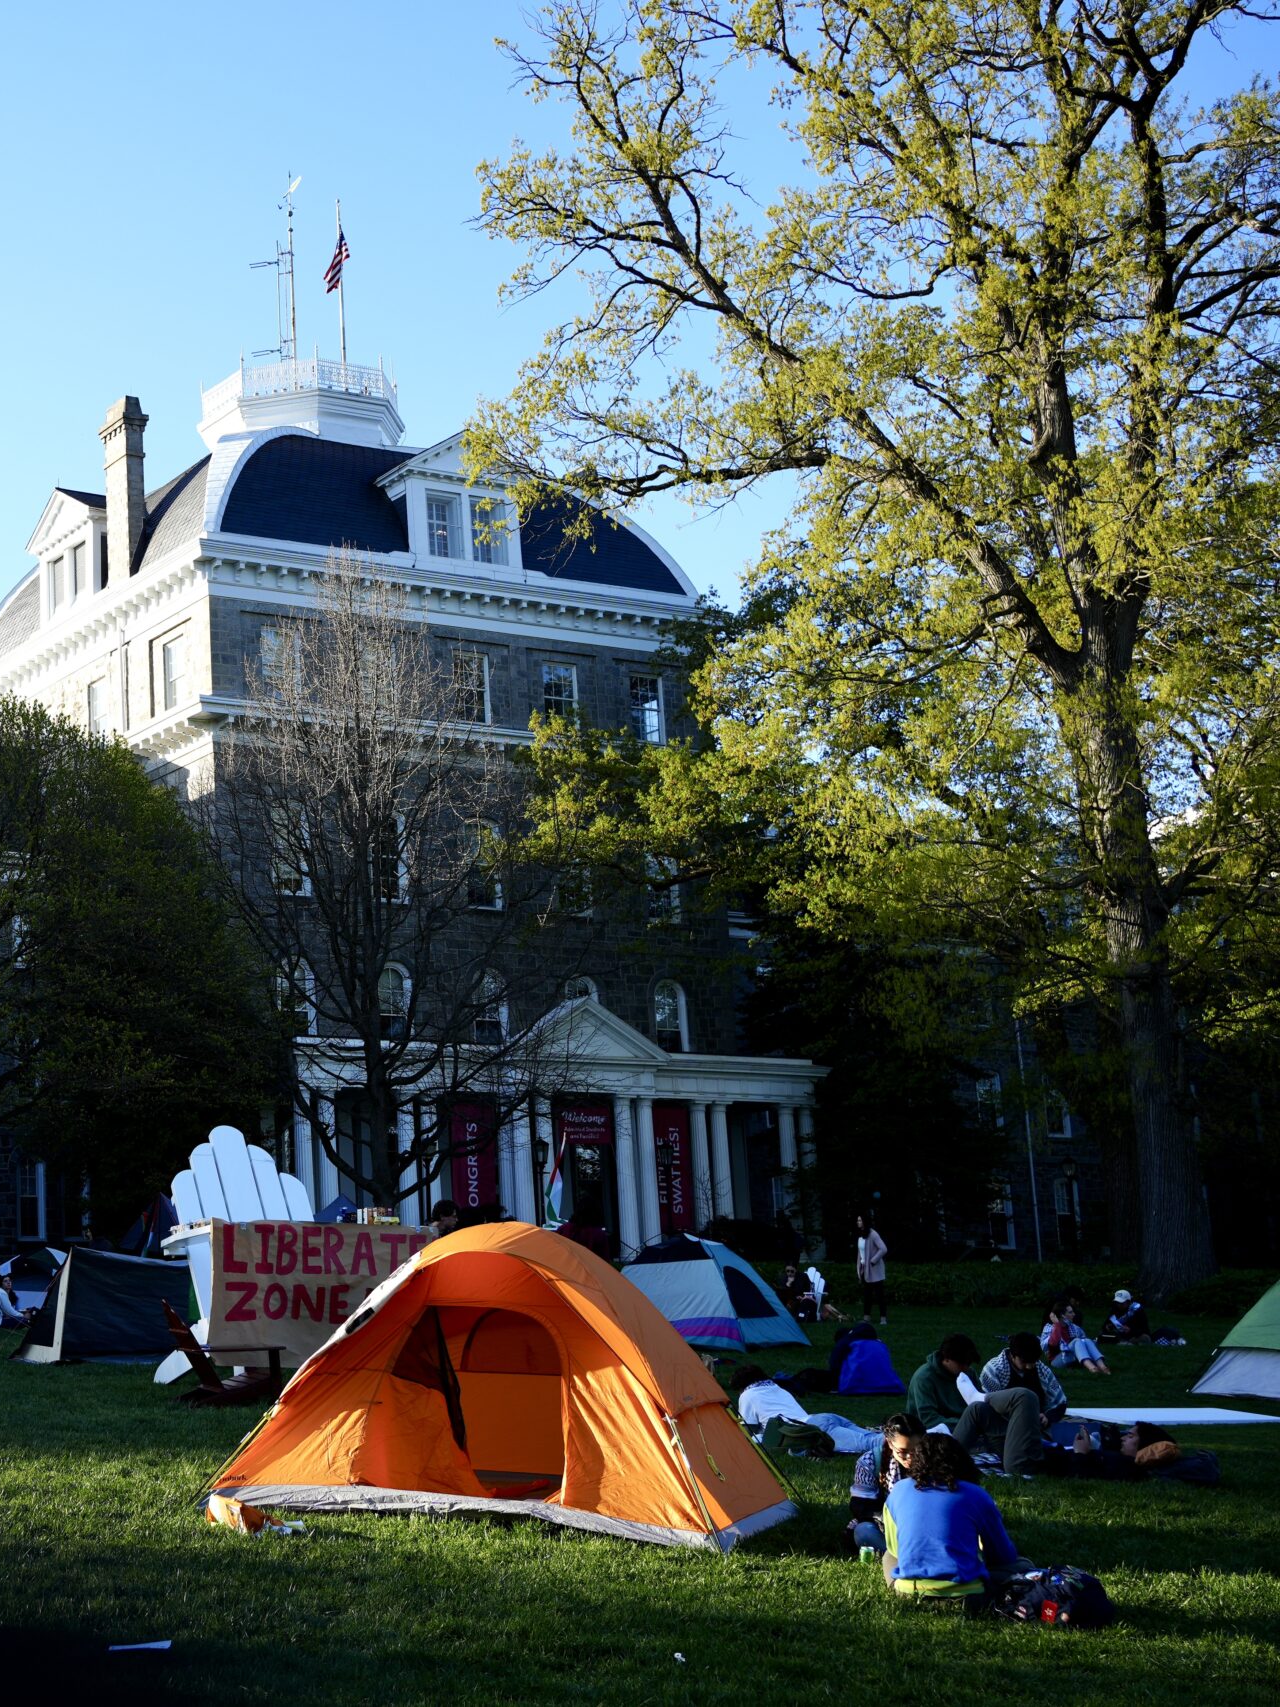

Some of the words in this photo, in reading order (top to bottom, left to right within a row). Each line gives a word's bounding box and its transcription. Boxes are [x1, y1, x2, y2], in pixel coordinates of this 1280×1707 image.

[561, 1111, 606, 1125] Welcome
[467, 1122, 479, 1208] ONGRTS
[657, 1136, 668, 1204] FUTE
[222, 1222, 441, 1276] LIBERAT
[225, 1281, 350, 1324] ZONE
